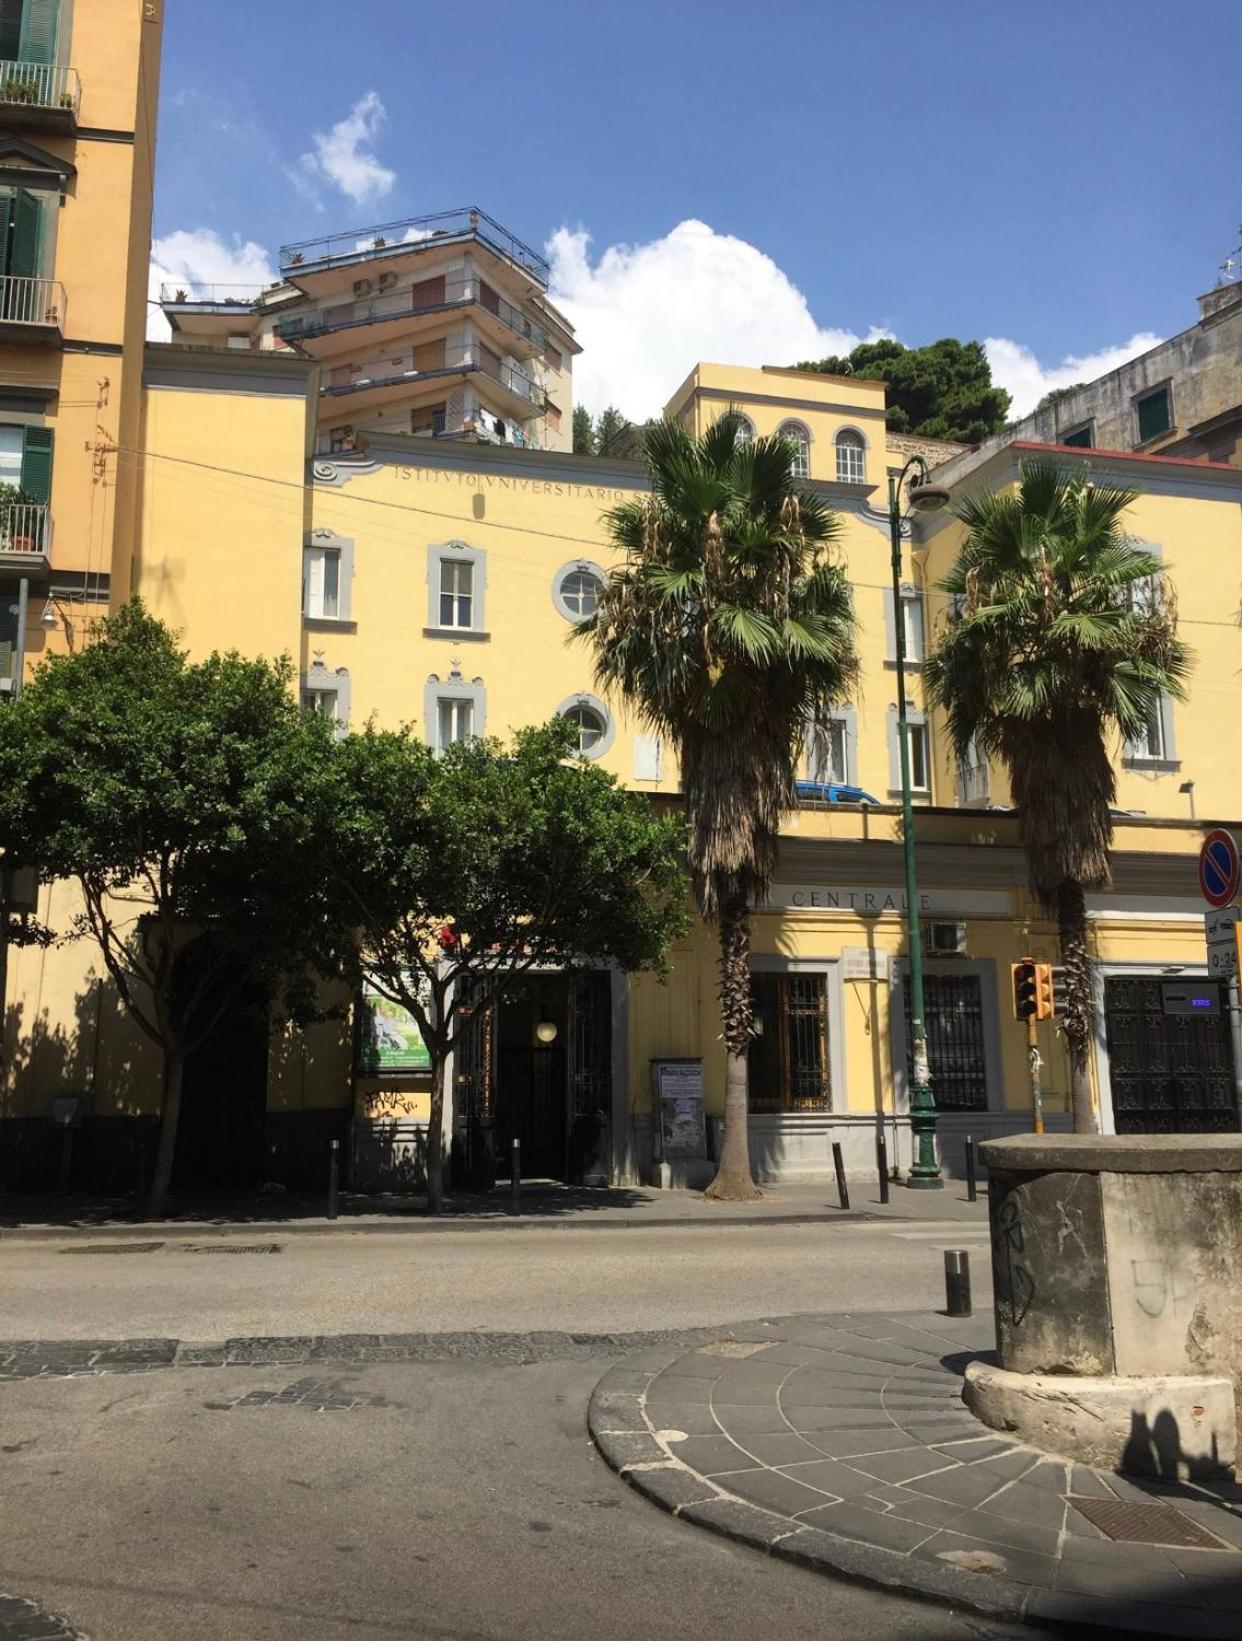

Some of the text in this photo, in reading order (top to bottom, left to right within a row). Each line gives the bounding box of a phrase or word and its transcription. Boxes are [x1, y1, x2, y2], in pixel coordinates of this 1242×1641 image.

[394, 465, 477, 488] ISTITVTO
[485, 476, 624, 502] VNIVERSITARIO
[792, 891, 931, 910] CENTRALE
